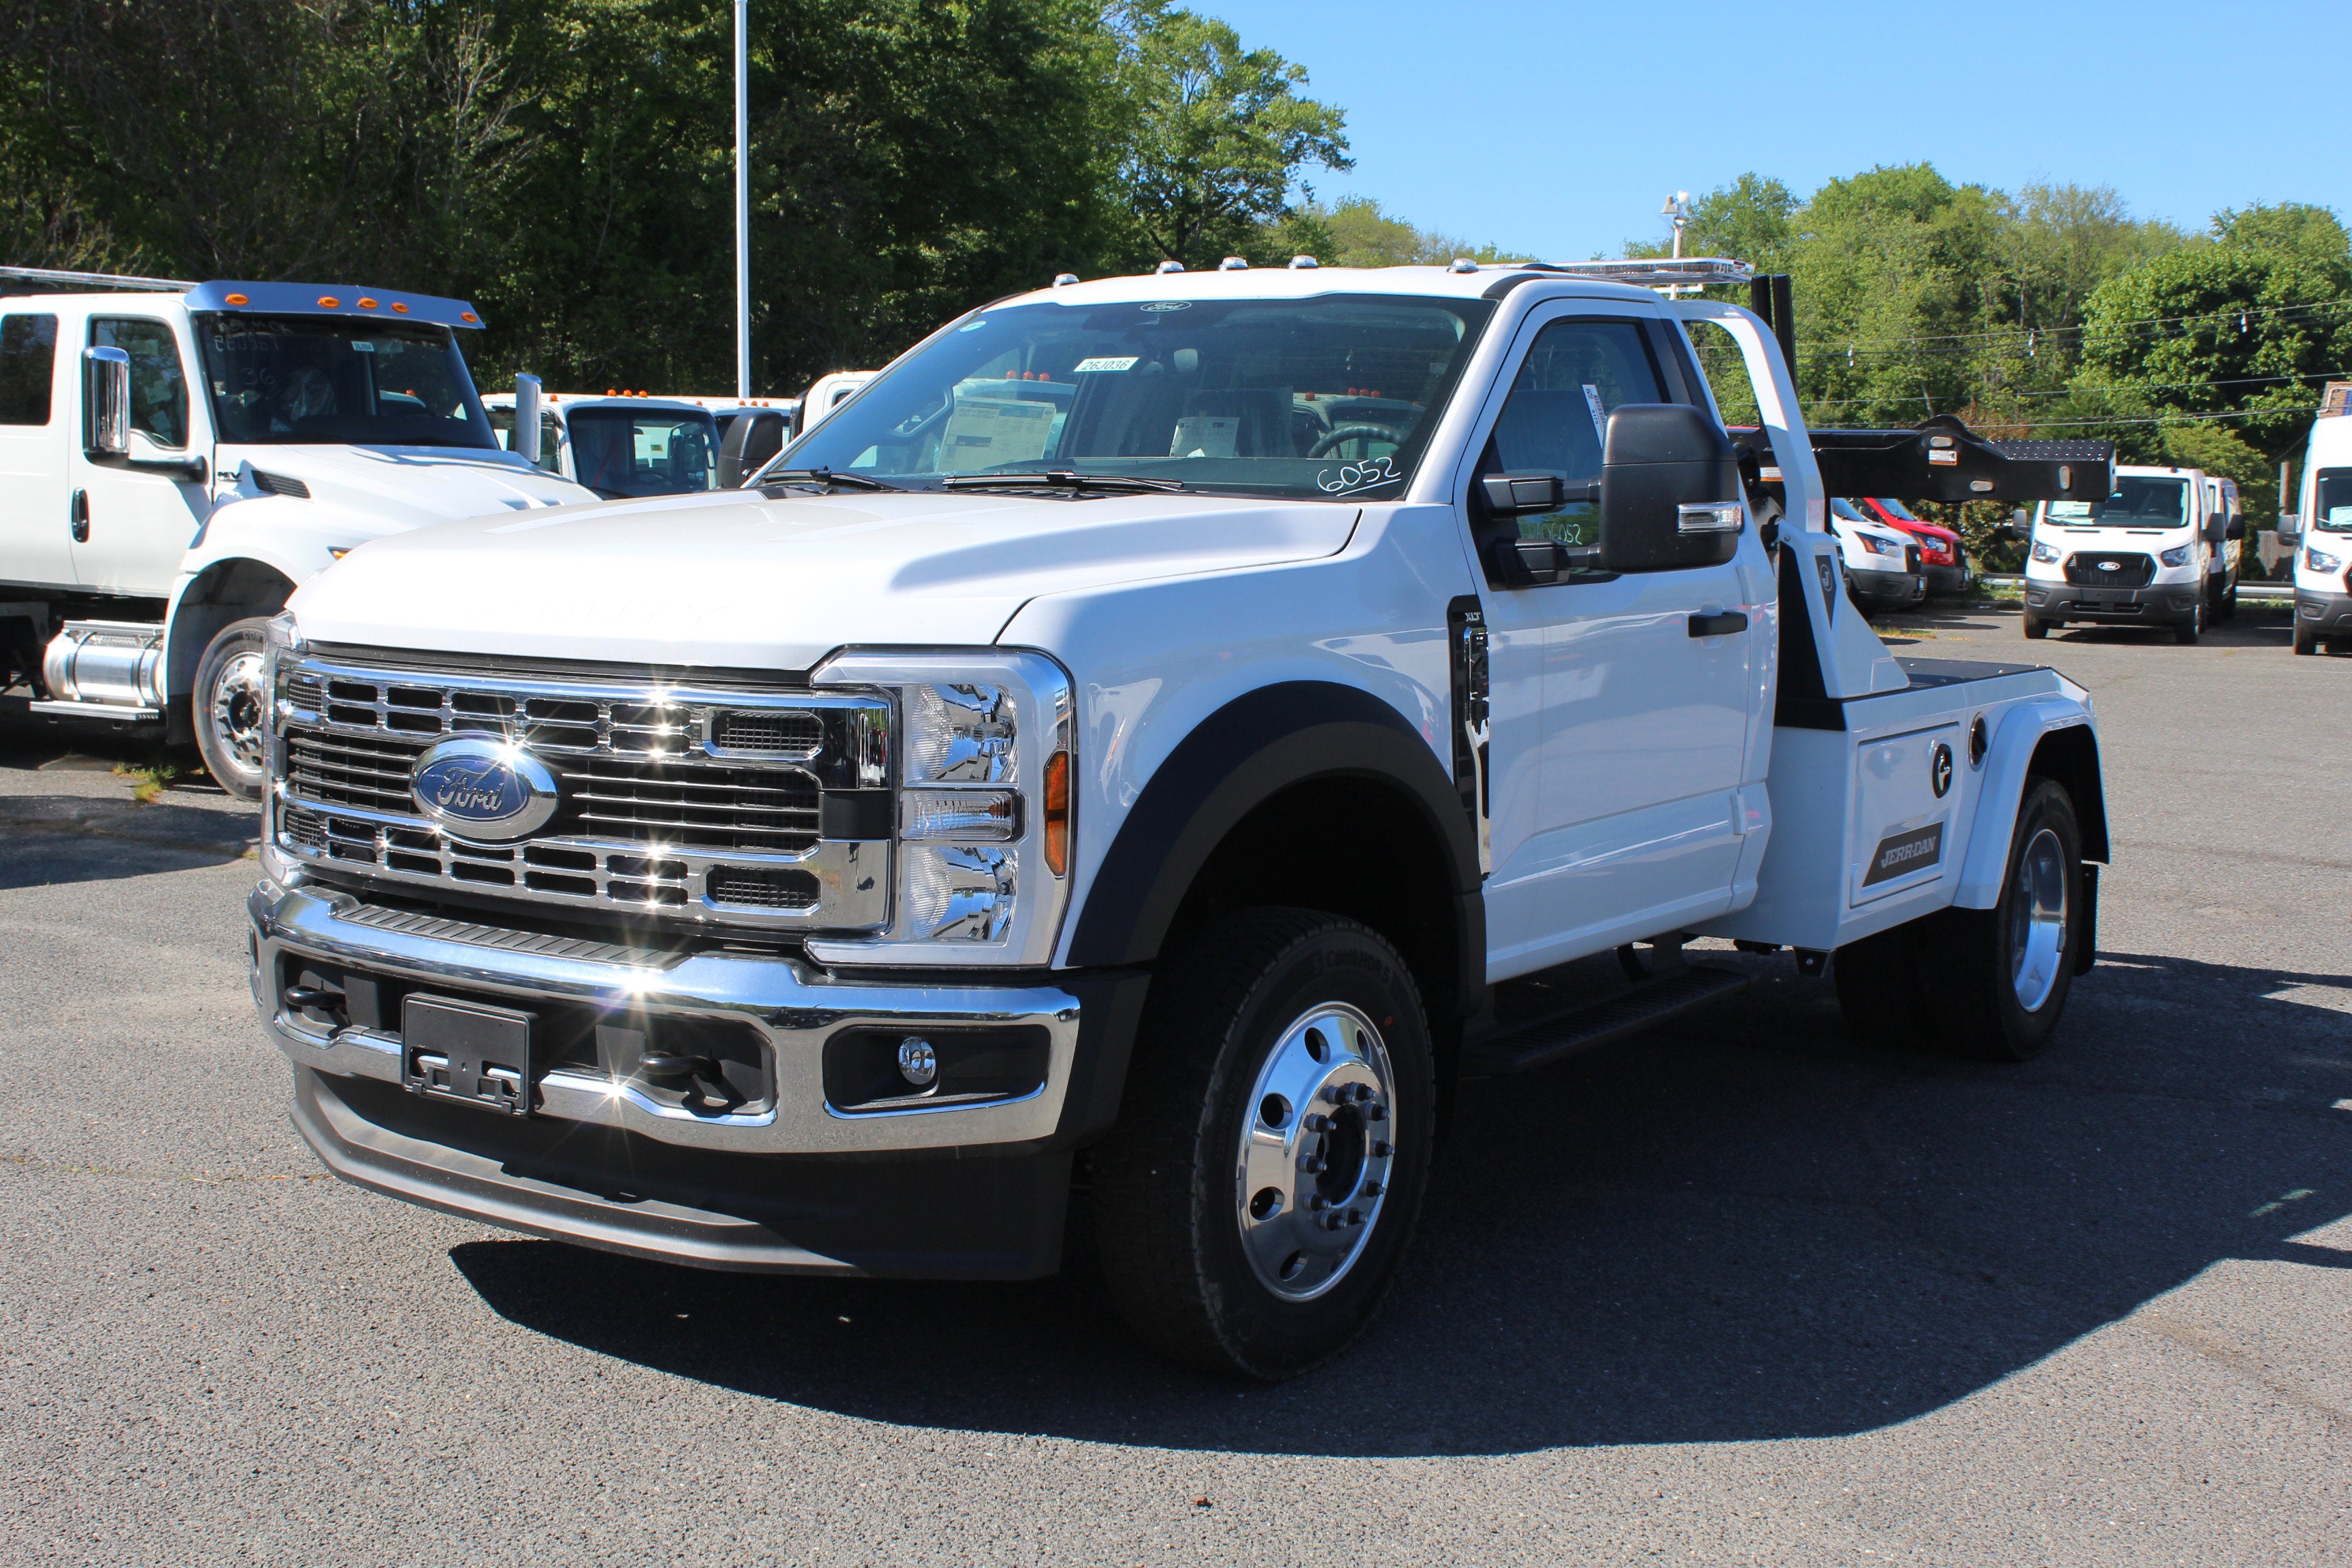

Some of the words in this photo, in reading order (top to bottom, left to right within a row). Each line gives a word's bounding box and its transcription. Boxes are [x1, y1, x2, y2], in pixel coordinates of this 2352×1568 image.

[1147, 301, 1185, 310] Ford
[1081, 360, 1130, 370] 26J036
[1317, 457, 1401, 492] 6052
[1465, 612, 1482, 622] XLT
[437, 766, 506, 812] Ford
